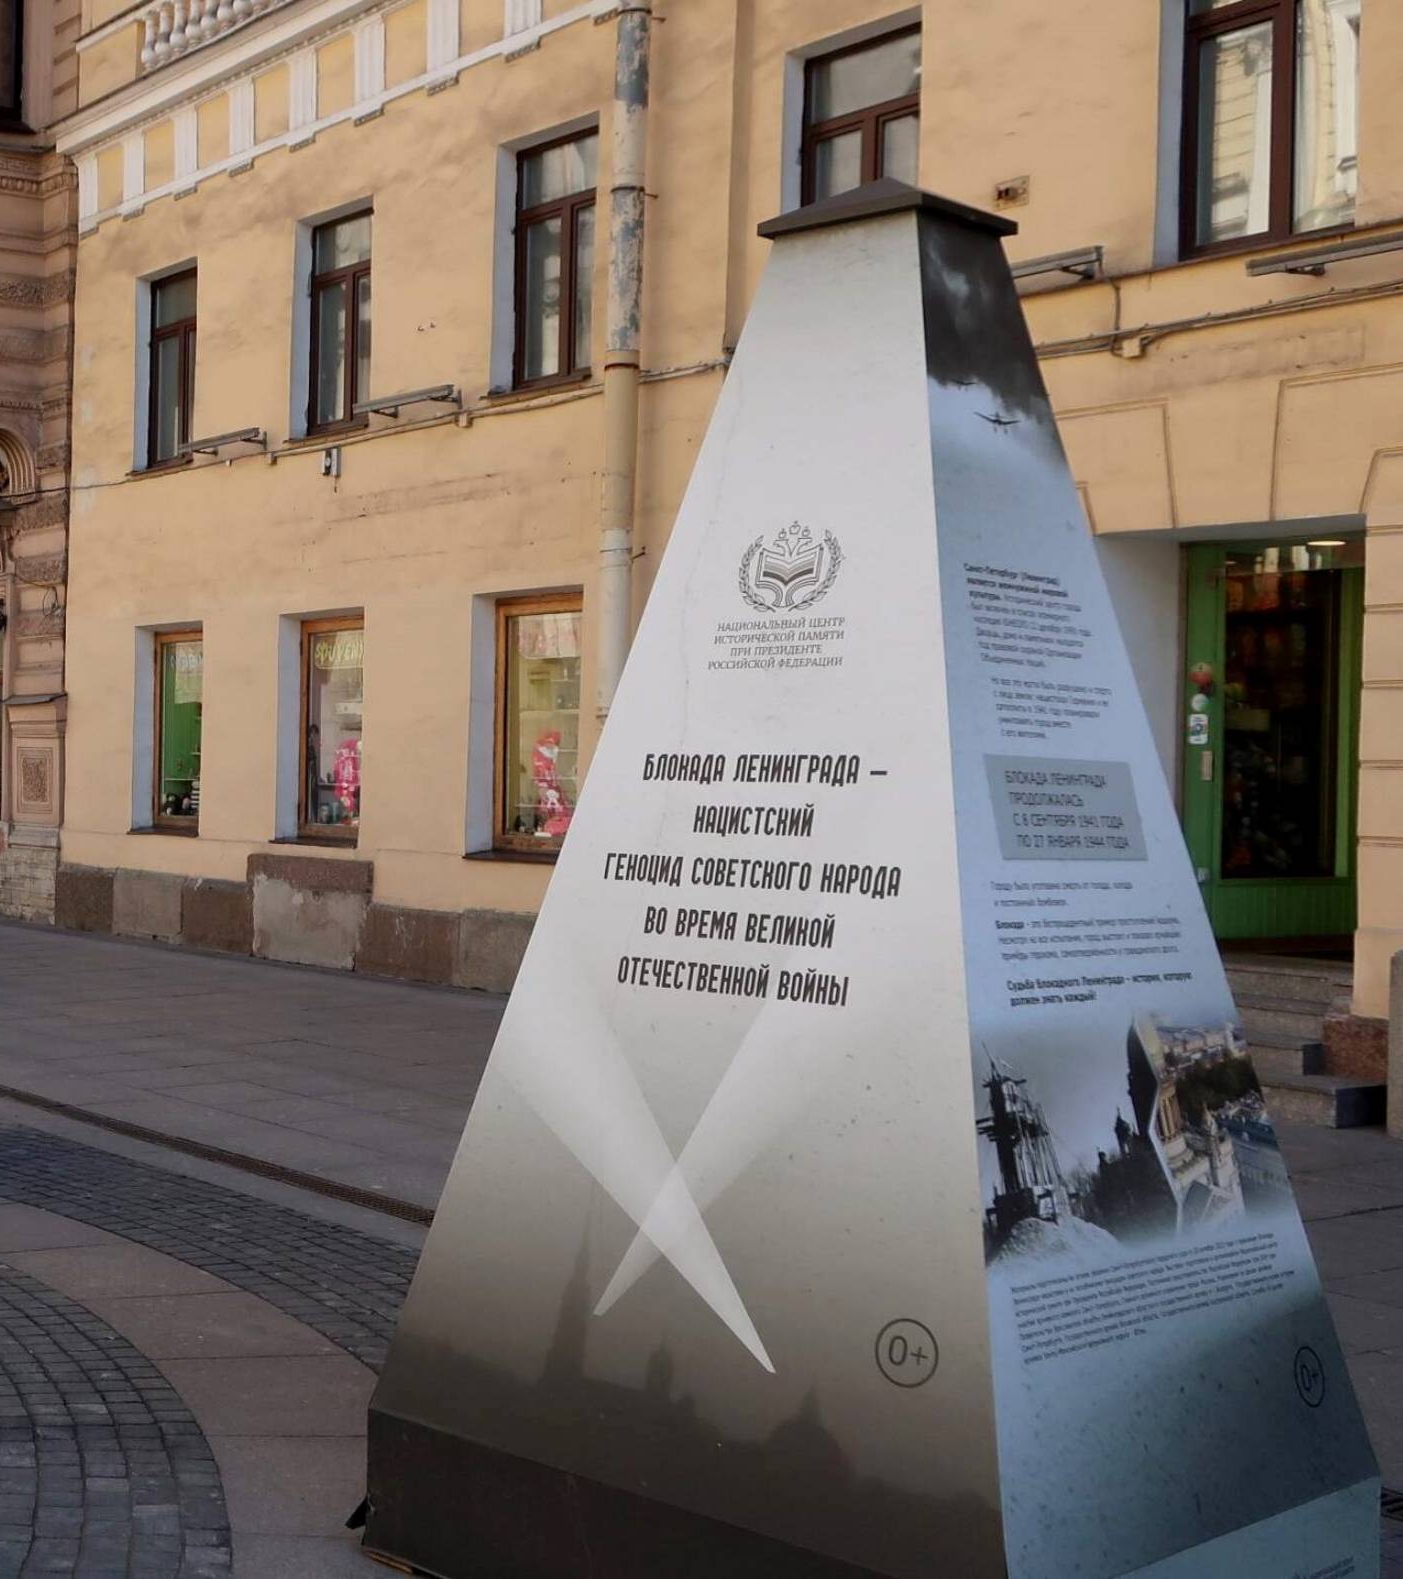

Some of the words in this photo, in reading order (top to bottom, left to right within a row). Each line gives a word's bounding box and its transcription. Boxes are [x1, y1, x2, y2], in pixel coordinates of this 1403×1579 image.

[718, 618, 805, 632] НАЦИОНАЛЬНЫЙ
[809, 617, 845, 628] ЦЕНТР
[714, 631, 795, 644] ИСТОРИЧЕСКОЙ
[798, 631, 844, 640] ПАМЯТИ
[731, 648, 750, 656] ПРИ
[754, 645, 822, 655] ПРЕЗИДЕНТЕ
[708, 657, 775, 669] РОССИЙСКОЙ
[779, 657, 842, 668] ФЕДЕРАЦИИ
[643, 754, 726, 785] БЛОКАДА
[733, 754, 860, 786] ЛЕНИНГРАДА
[1005, 770, 1047, 785] БЛОКАДА
[1051, 773, 1106, 788] ЛЕНИНГРАДА
[1009, 792, 1084, 806] ПРОДОЛЖАЛАСЬ
[693, 804, 814, 836] НАЦИСТСКИЙ
[1013, 813, 1020, 826] С
[1030, 814, 1075, 827] СЕНТЯБРЯ
[1100, 816, 1124, 828] ГОДА
[1016, 834, 1031, 848] ПО
[1047, 835, 1081, 848] ЯНВАРЯ
[1106, 836, 1129, 849] ГОДА
[604, 853, 683, 886] ГЕНОЦИД
[692, 858, 812, 891] СОВЕТСКОГО
[820, 864, 901, 899] НАРОДА
[644, 906, 667, 934] ВО
[675, 909, 737, 940] ВРЕМЯ
[745, 913, 835, 948] ВЕЛИКОЙ
[618, 956, 769, 998] ОТЕЧЕСТВЕННОЙ
[777, 968, 849, 1006] ВОЙНЫ
[888, 1334, 929, 1367] 0+
